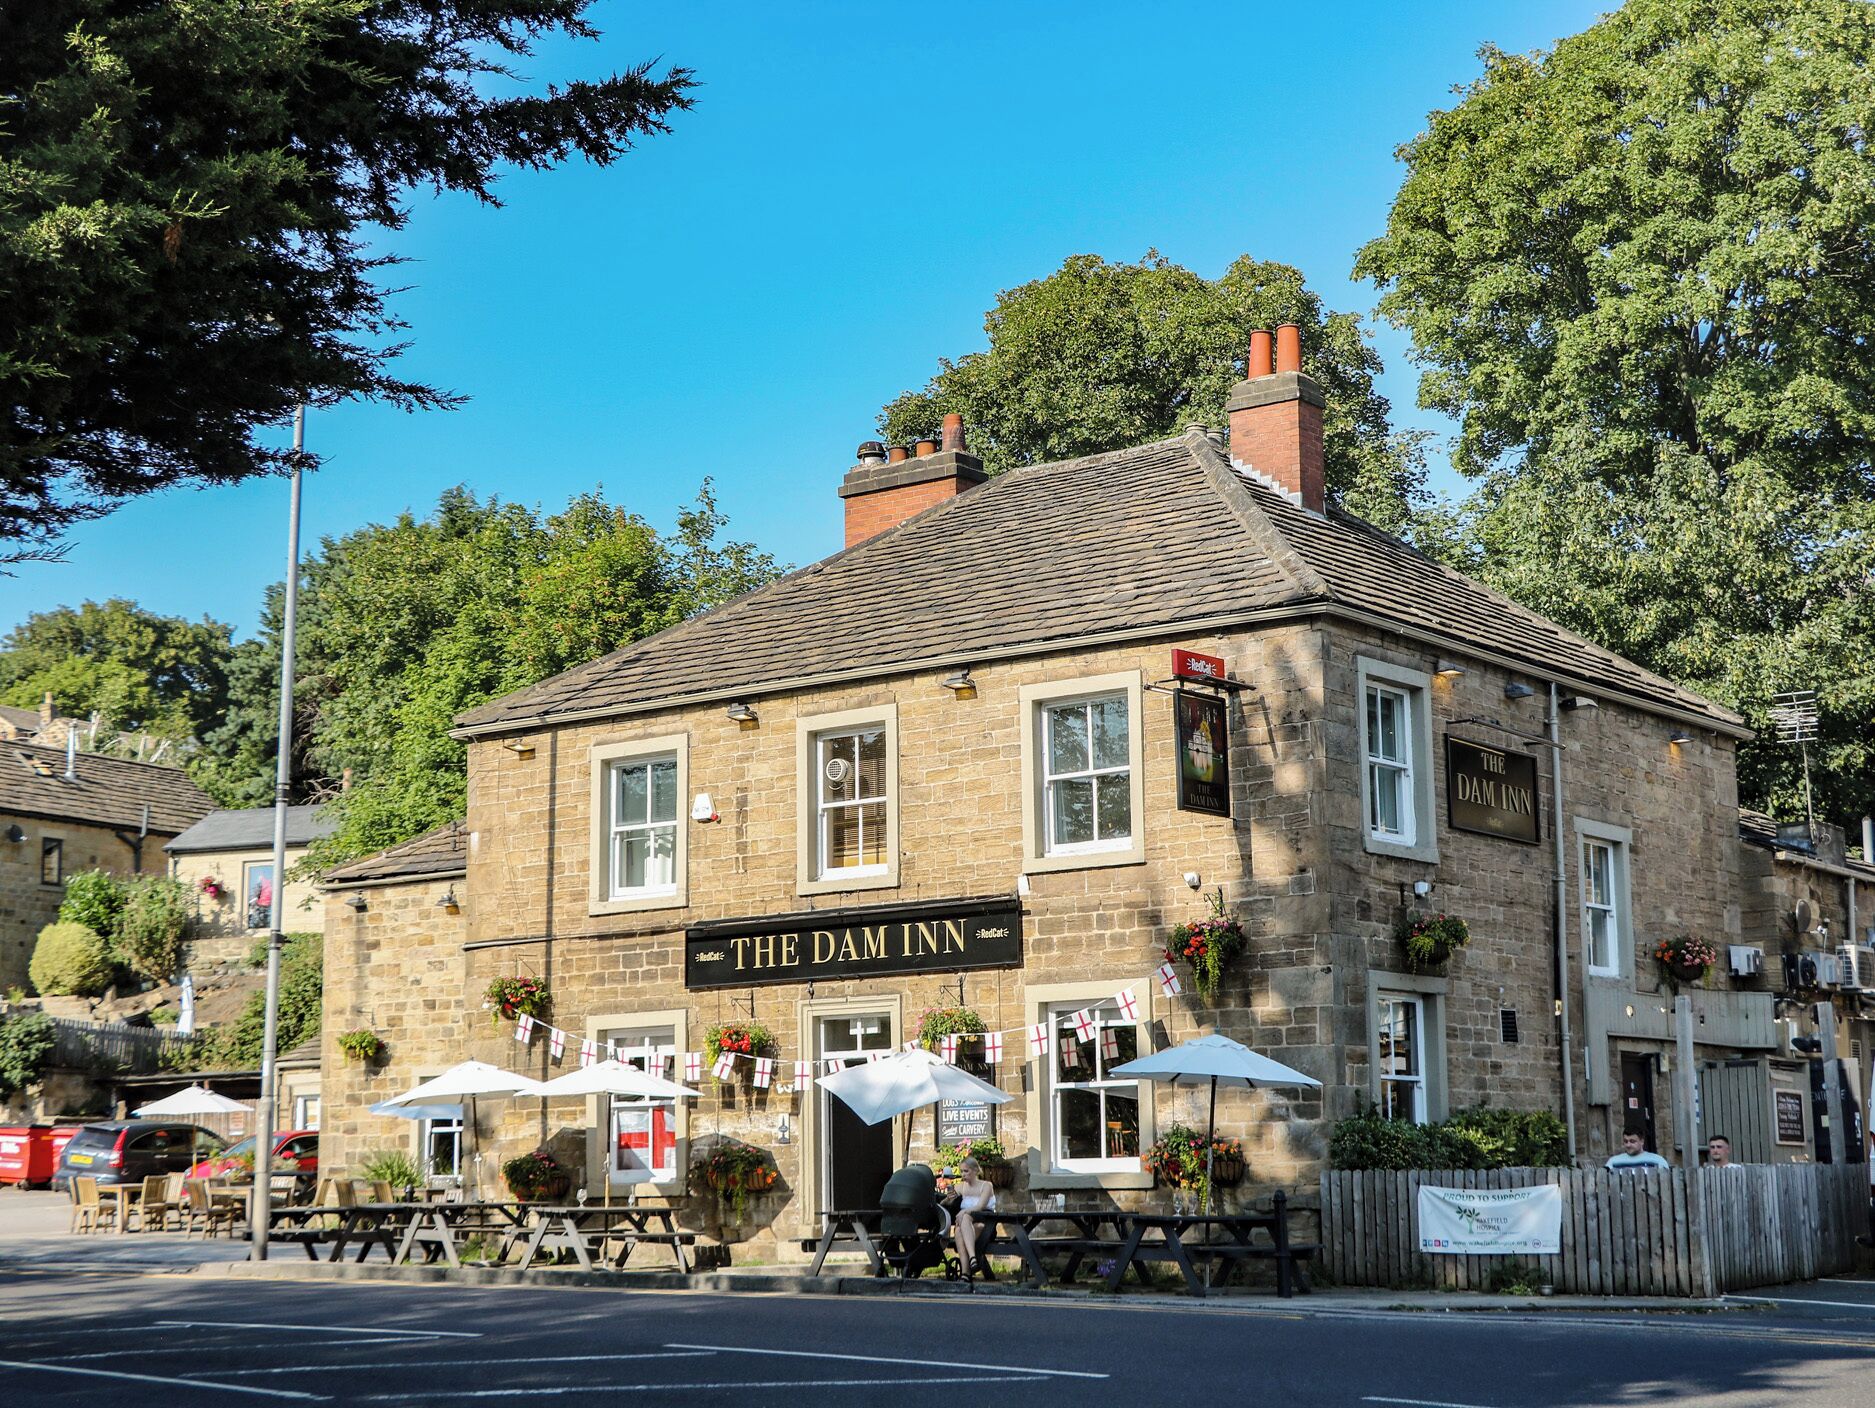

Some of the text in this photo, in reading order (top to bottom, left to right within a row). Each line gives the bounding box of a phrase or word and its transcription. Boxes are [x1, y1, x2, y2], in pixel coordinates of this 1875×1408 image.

[1191, 657, 1212, 675] RedCat
[1480, 752, 1506, 775] THE
[1457, 772, 1531, 816] DAM INN
[980, 927, 1004, 939] RedCat
[730, 919, 968, 971] THE DAM INN
[699, 951, 720, 962] RedCat
[942, 1109, 988, 1122] LIVE EVENTS
[1443, 1192, 1531, 1202] PROUD TO SUPPORT
